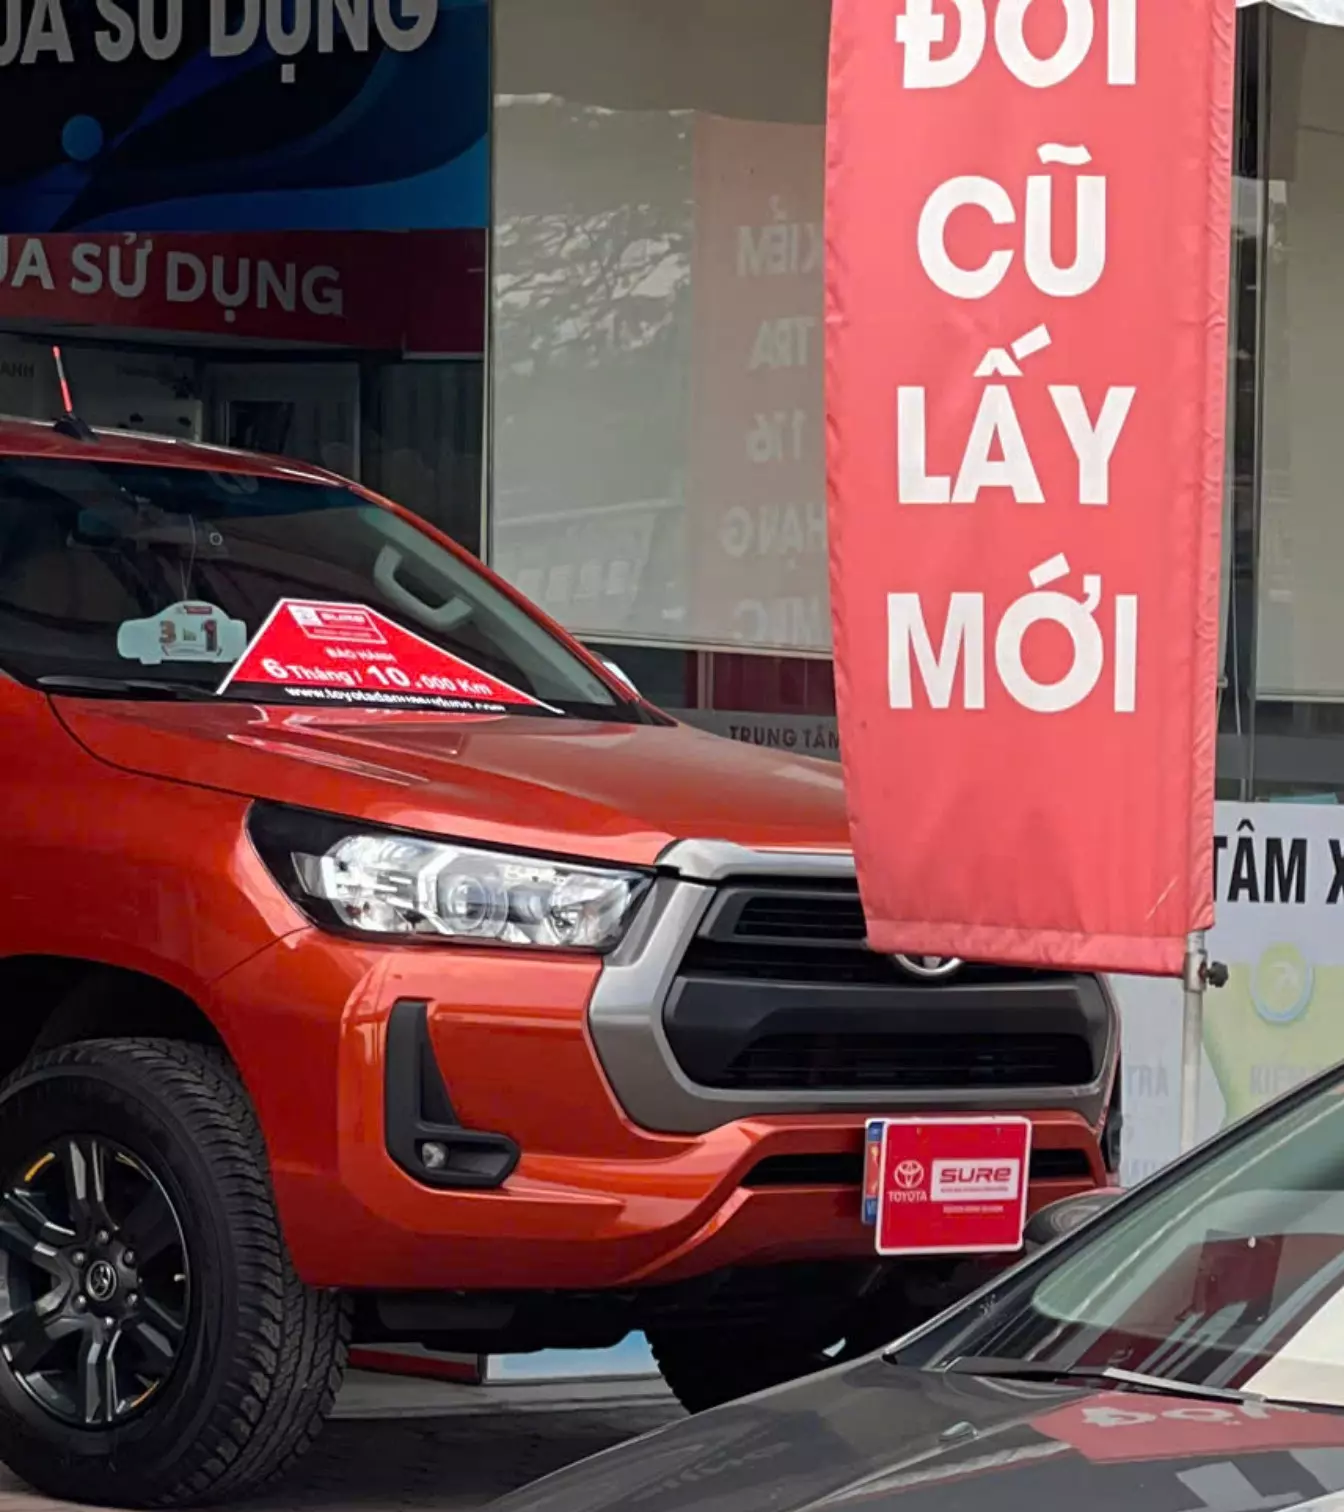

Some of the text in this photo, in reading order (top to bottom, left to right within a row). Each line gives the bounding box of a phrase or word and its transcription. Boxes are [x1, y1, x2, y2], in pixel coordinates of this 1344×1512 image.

[210, 0, 439, 84] DỤNG
[916, 142, 1108, 300] CŨ
[71, 232, 153, 299] SỬ
[167, 251, 345, 323] DỤNG
[897, 323, 1137, 506] LẤY
[261, 658, 288, 679] 6
[459, 678, 492, 697] Km
[887, 552, 1139, 714] MỚI
[888, 1190, 928, 1203] TOYOTA
